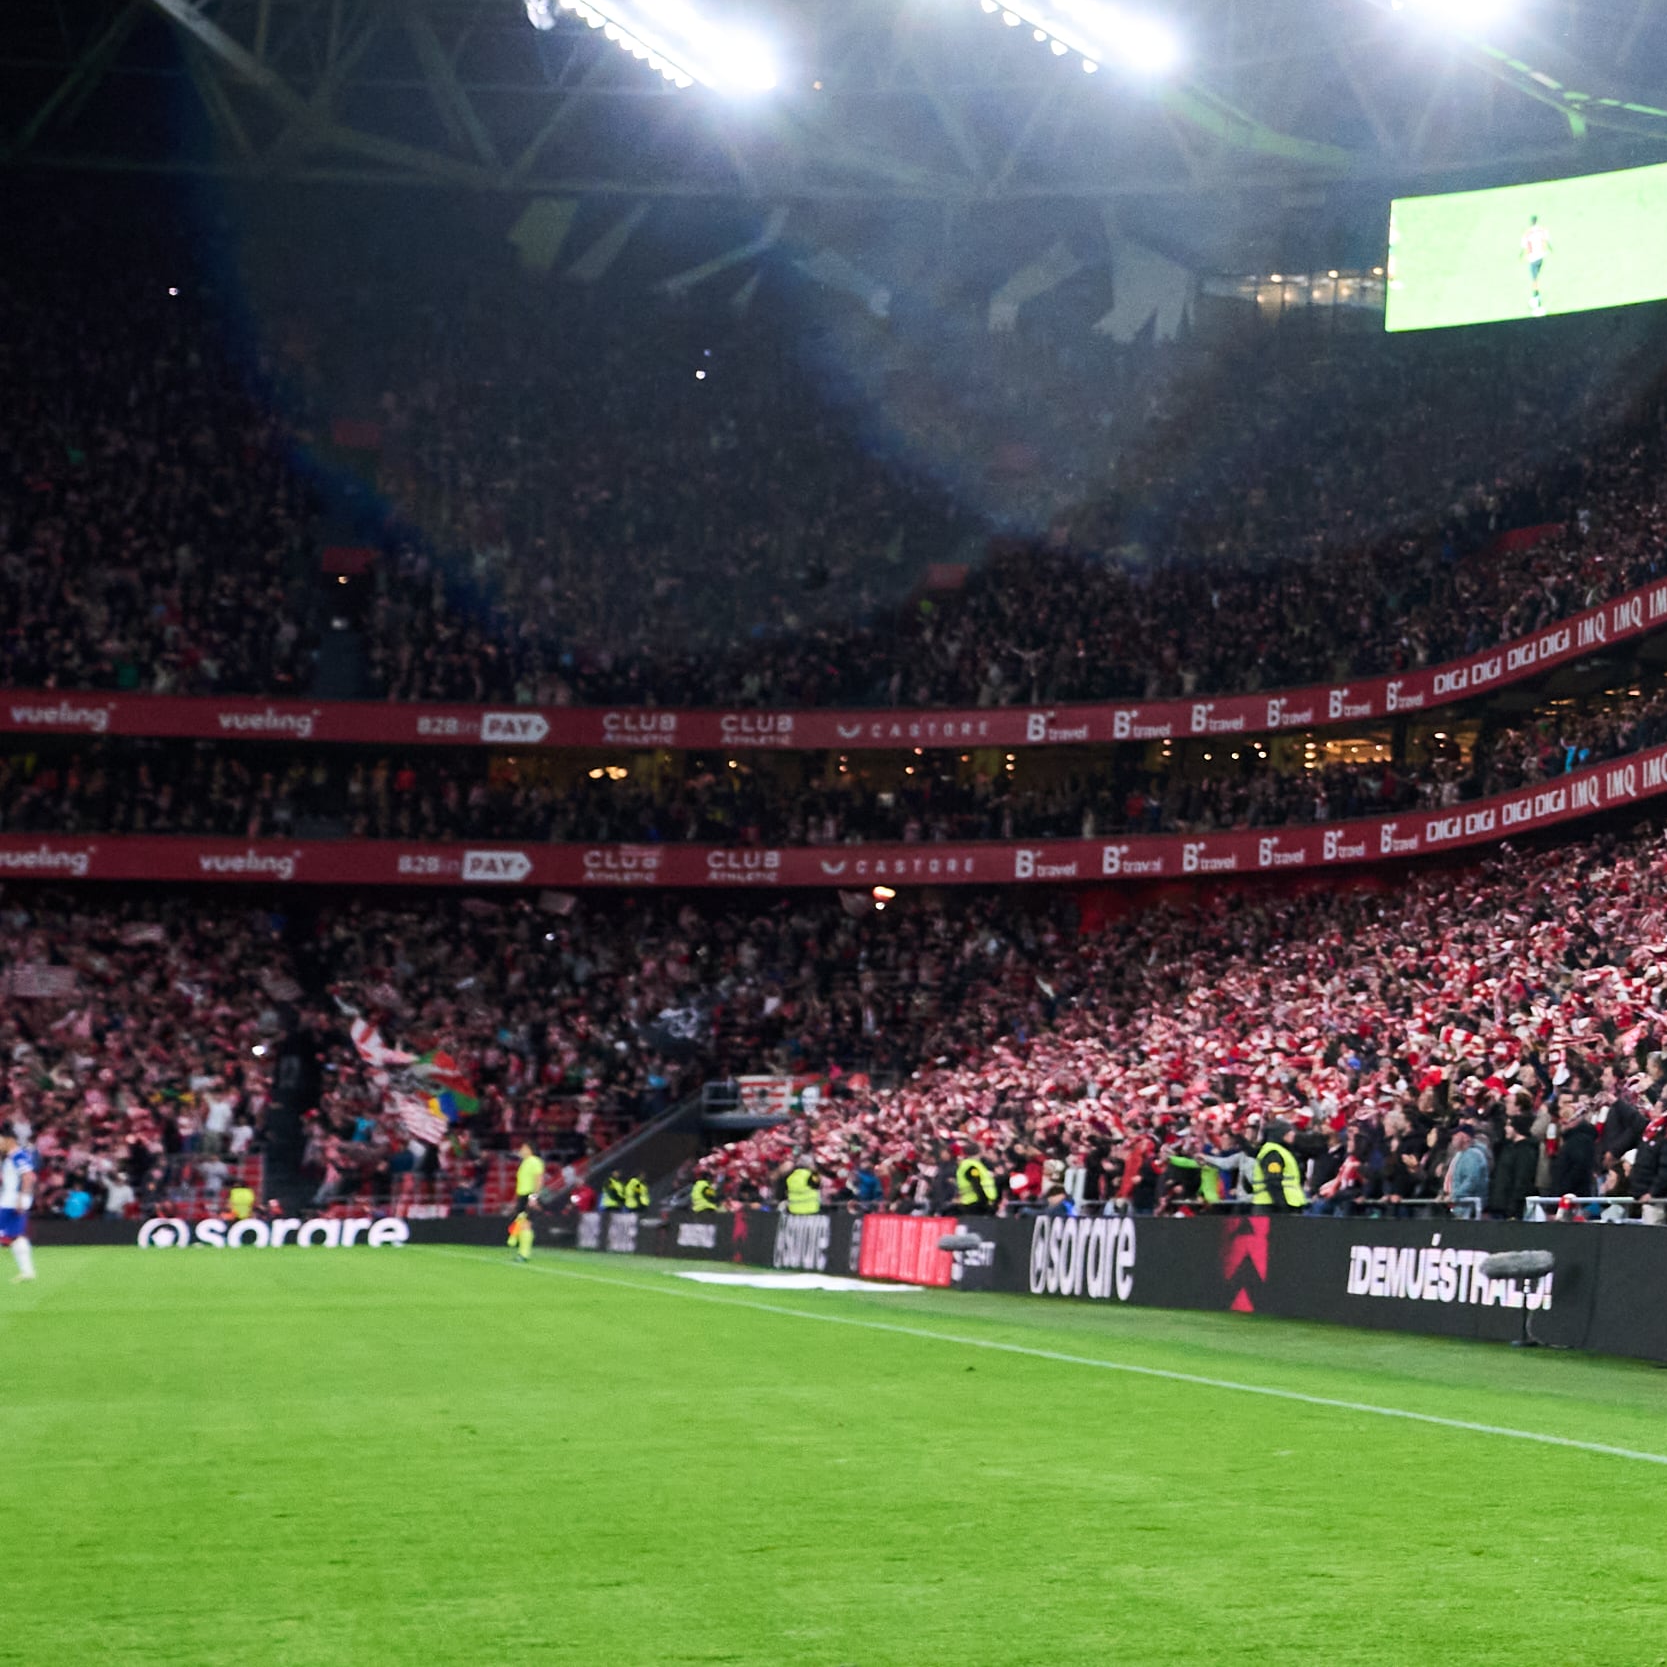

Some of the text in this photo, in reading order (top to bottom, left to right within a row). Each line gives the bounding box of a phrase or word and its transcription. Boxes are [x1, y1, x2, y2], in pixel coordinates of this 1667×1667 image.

[1578, 612, 1606, 648] IMQ
[1613, 596, 1643, 633] IMQ
[1571, 775, 1601, 810] IMQ
[1606, 764, 1637, 799] IMQ
[195, 1217, 410, 1248] sorare
[1047, 1215, 1137, 1301] sorare
